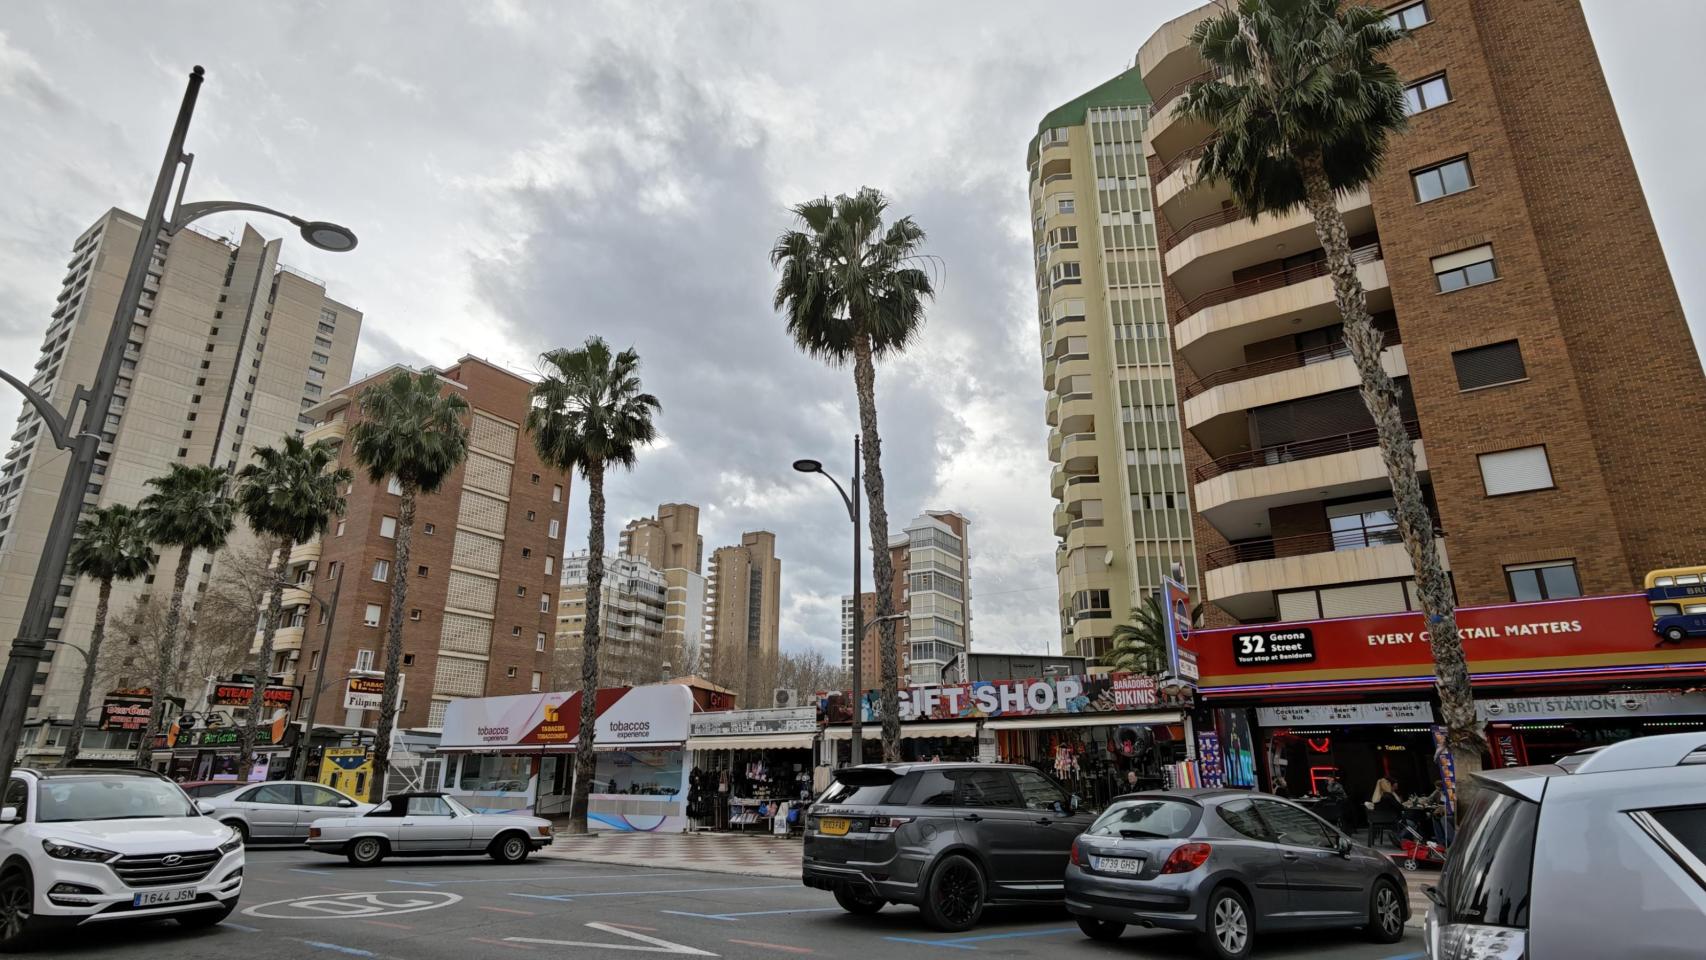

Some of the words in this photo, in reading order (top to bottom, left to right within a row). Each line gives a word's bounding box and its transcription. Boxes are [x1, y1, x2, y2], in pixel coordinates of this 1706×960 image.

[1269, 633, 1305, 642] Gerona
[1367, 632, 1414, 646] EVERY
[1419, 626, 1501, 642] CKTAIL
[1504, 620, 1583, 636] MATTERS
[1239, 634, 1266, 654] 32
[1271, 643, 1303, 652] Street
[1113, 677, 1154, 689] BAÑADORES
[262, 690, 293, 700] OUSE
[975, 680, 1081, 713] SHOP
[1114, 689, 1156, 705] BIKINIS
[349, 697, 383, 708] Filipina
[1507, 702, 1541, 714] BRIT
[1547, 699, 1617, 712] STATION
[477, 725, 509, 736] tobaccos
[609, 720, 650, 732] tobaccos
[786, 720, 816, 731] PRESS
[482, 735, 508, 743] experience
[617, 730, 650, 739] experience
[1100, 858, 1119, 868] 6739
[1120, 860, 1136, 869] GHS
[144, 891, 171, 903] 1644
[174, 890, 195, 900] JSN
